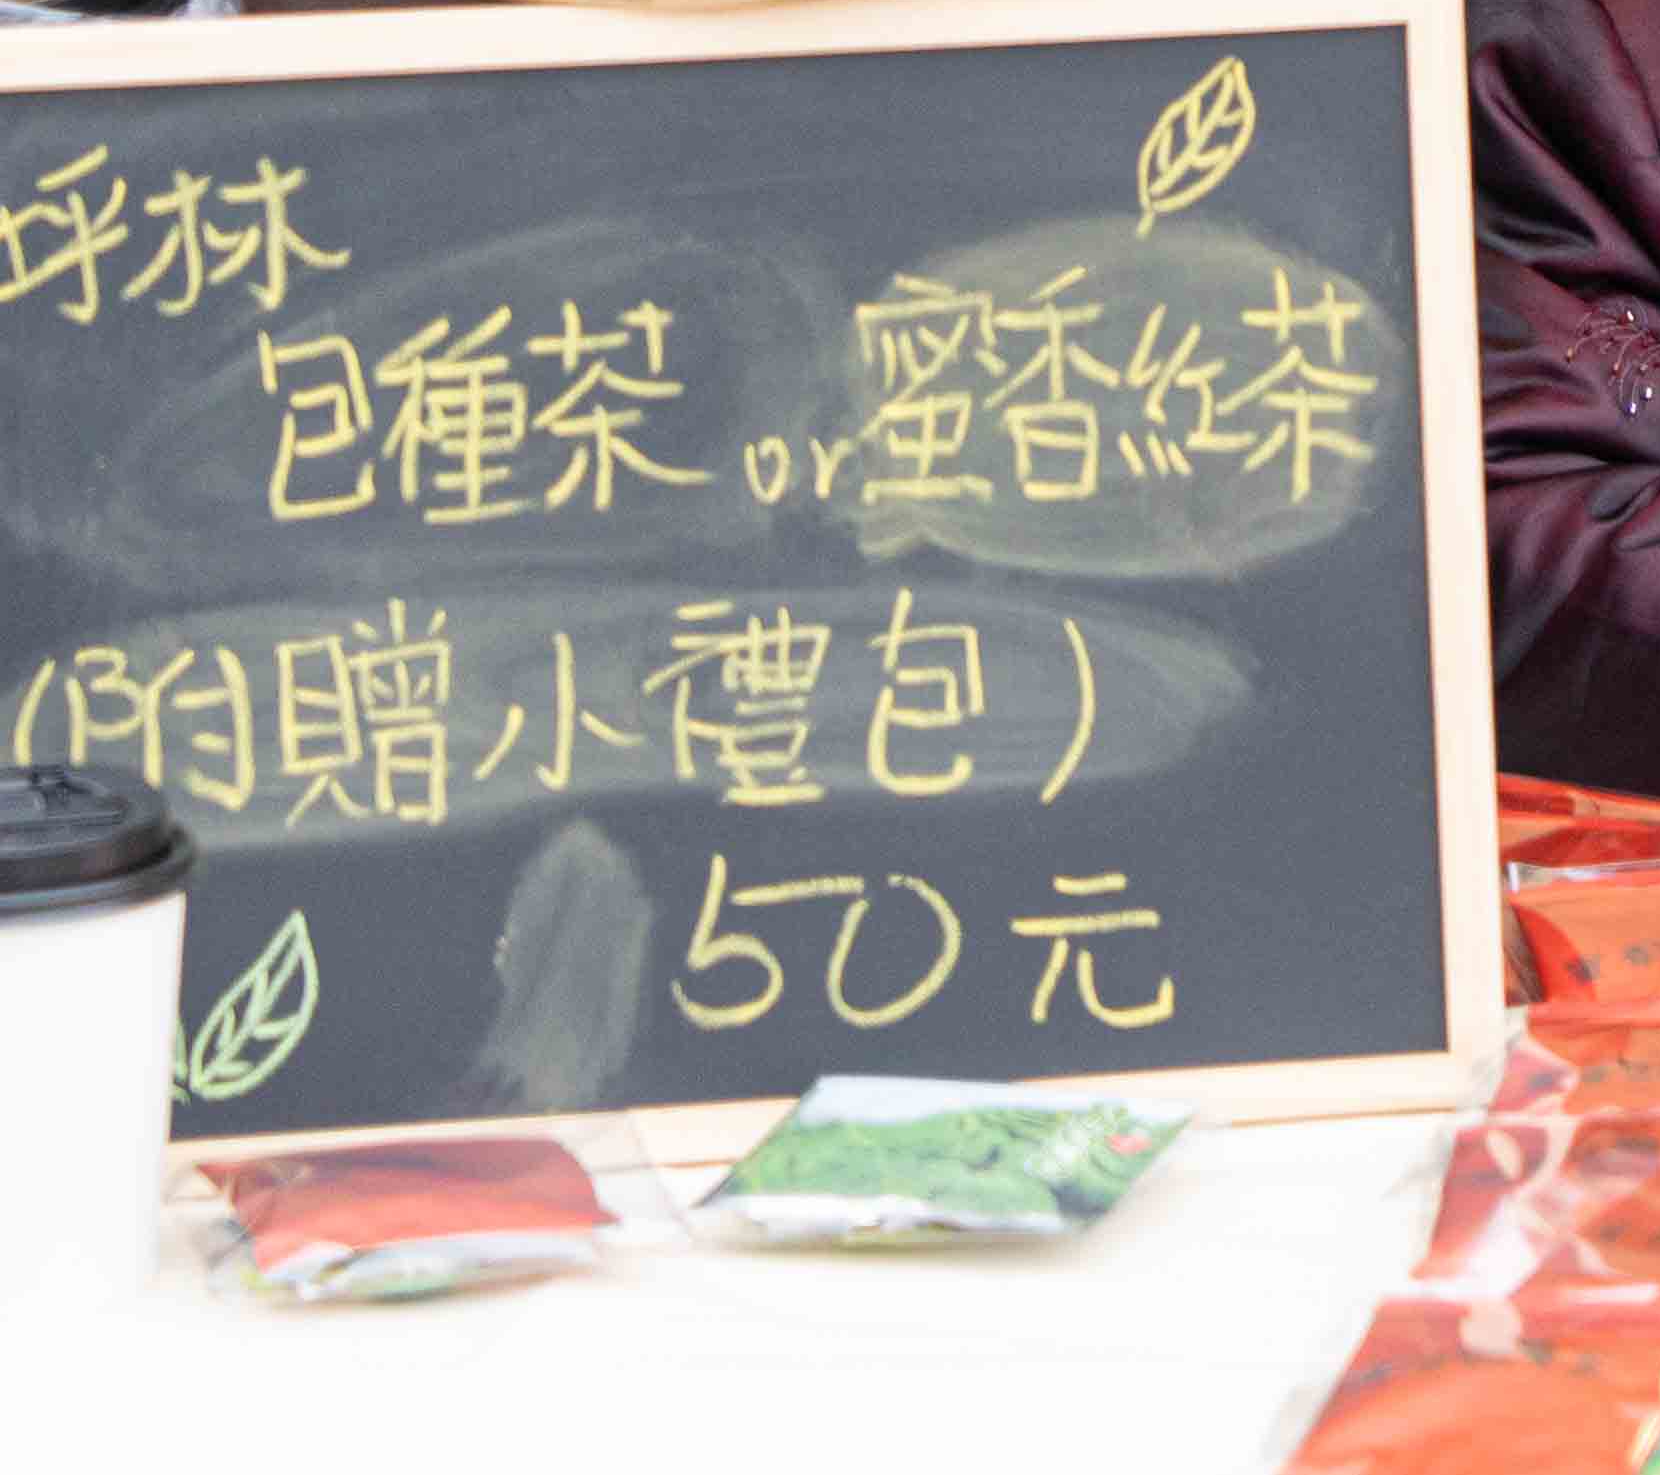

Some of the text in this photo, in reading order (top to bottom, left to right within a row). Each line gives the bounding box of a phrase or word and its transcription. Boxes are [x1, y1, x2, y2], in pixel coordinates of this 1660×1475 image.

[256, 264, 1382, 523] 包種茶 or 蜜香紅茶
